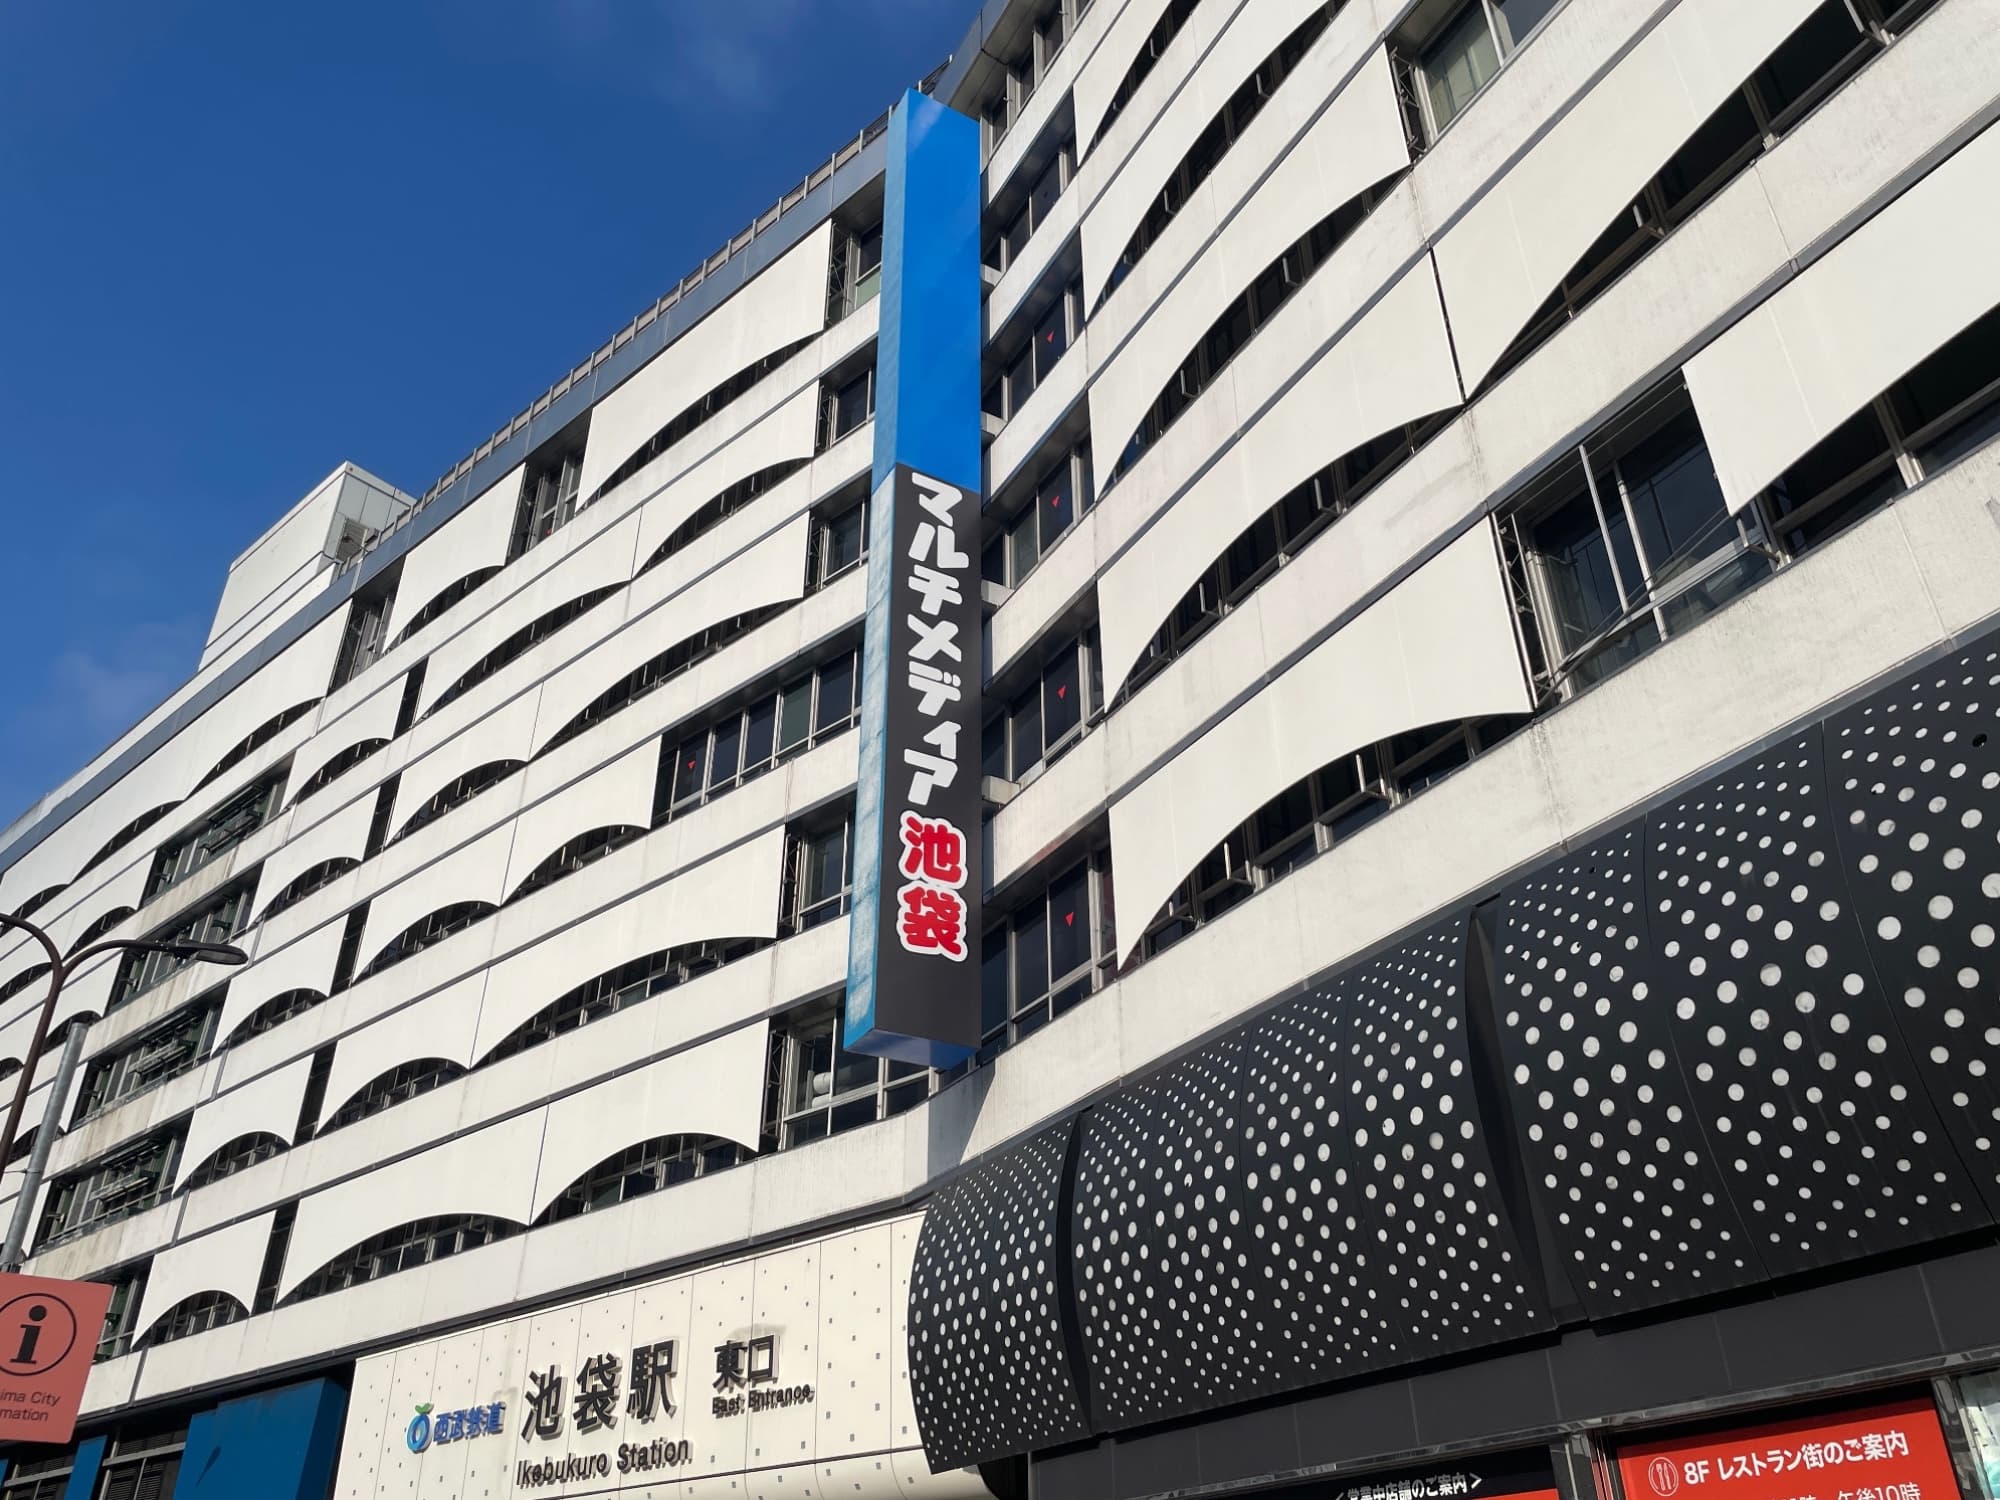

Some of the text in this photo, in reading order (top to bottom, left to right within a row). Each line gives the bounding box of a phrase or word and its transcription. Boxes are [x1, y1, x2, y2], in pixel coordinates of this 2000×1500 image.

[897, 471, 969, 963] マルチメディア池袋
[712, 1334, 778, 1391] 東口
[31, 1391, 61, 1407] City
[520, 1339, 679, 1444] 池袋駅
[712, 1384, 815, 1417] East Entrance
[516, 1436, 693, 1488] Ikebukuro Station
[1683, 1430, 1909, 1485] 8F レストラン街のご案内
